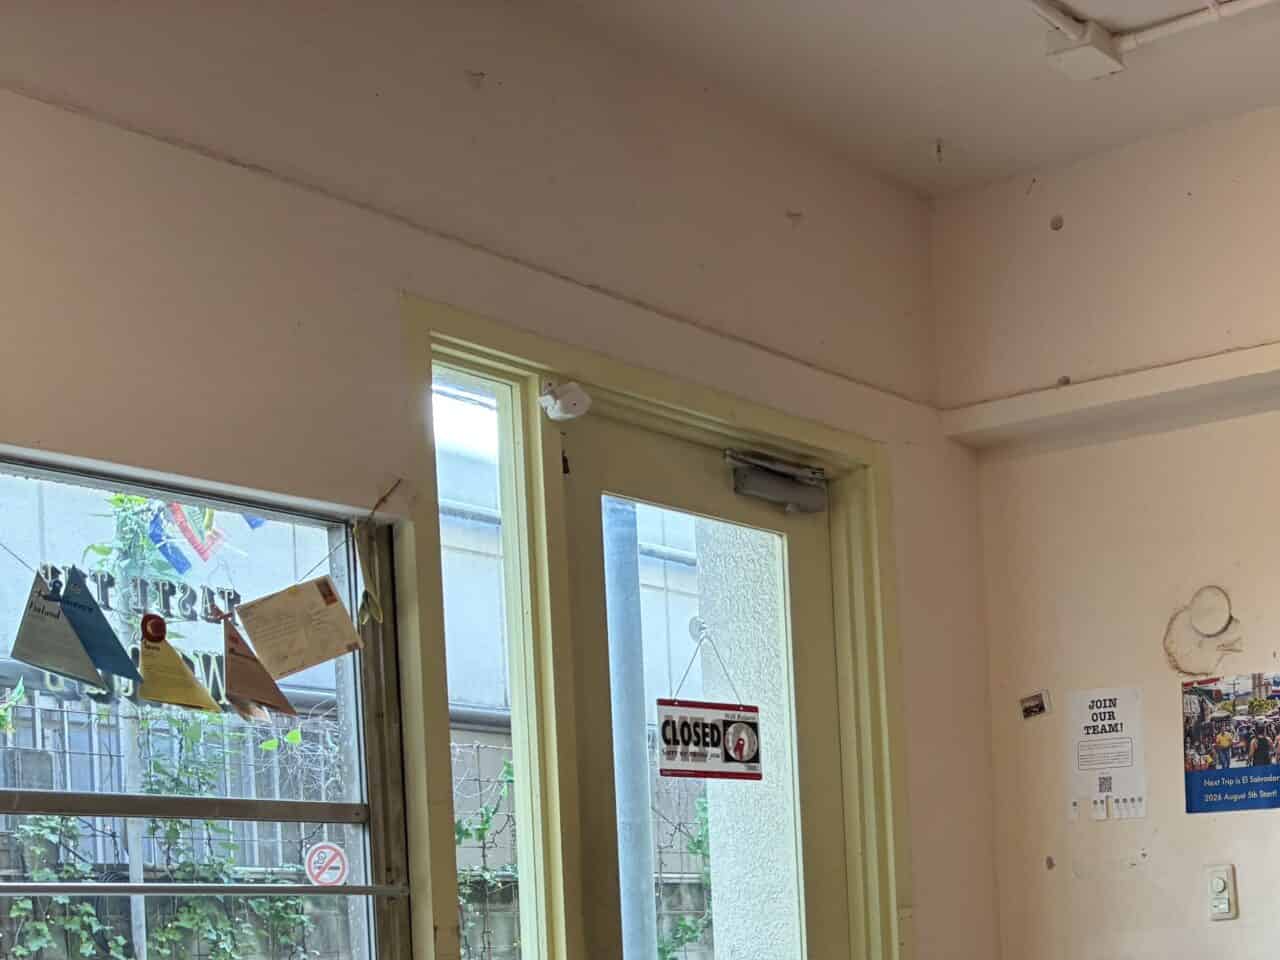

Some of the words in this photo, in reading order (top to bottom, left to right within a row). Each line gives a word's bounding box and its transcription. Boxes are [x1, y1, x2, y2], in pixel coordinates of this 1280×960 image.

[1088, 698, 1118, 711] JOIN
[1091, 710, 1116, 722] OUR
[661, 719, 722, 748] CLOSED
[1083, 722, 1124, 735] TEAM!
[1203, 778, 1220, 787] Next
[1221, 777, 1234, 786] Trip
[1249, 774, 1280, 784] Salvador
